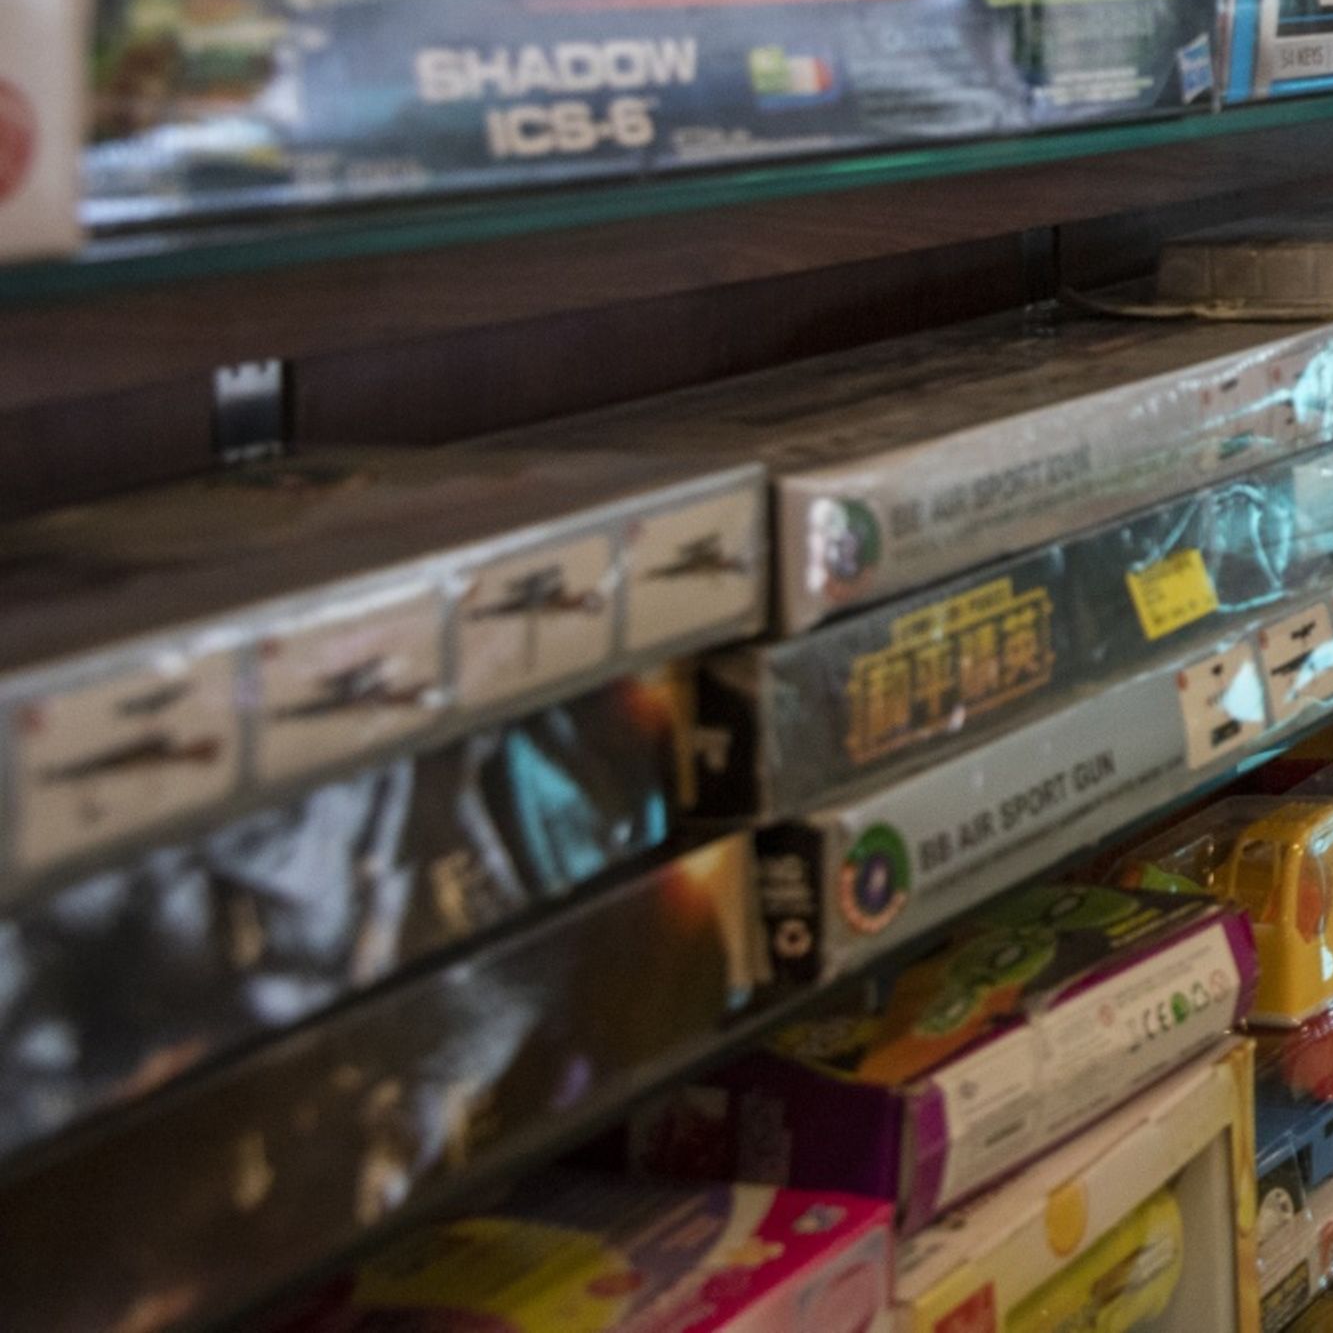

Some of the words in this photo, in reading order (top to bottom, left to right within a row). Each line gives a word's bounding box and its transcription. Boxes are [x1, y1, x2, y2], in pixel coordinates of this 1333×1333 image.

[416, 38, 697, 103] SHADOW
[1297, 44, 1323, 65] KEYS
[487, 98, 655, 157] ICS-6
[960, 811, 995, 849] AIR
[1001, 774, 1068, 833] SPORT
[1072, 751, 1117, 794] GUN
